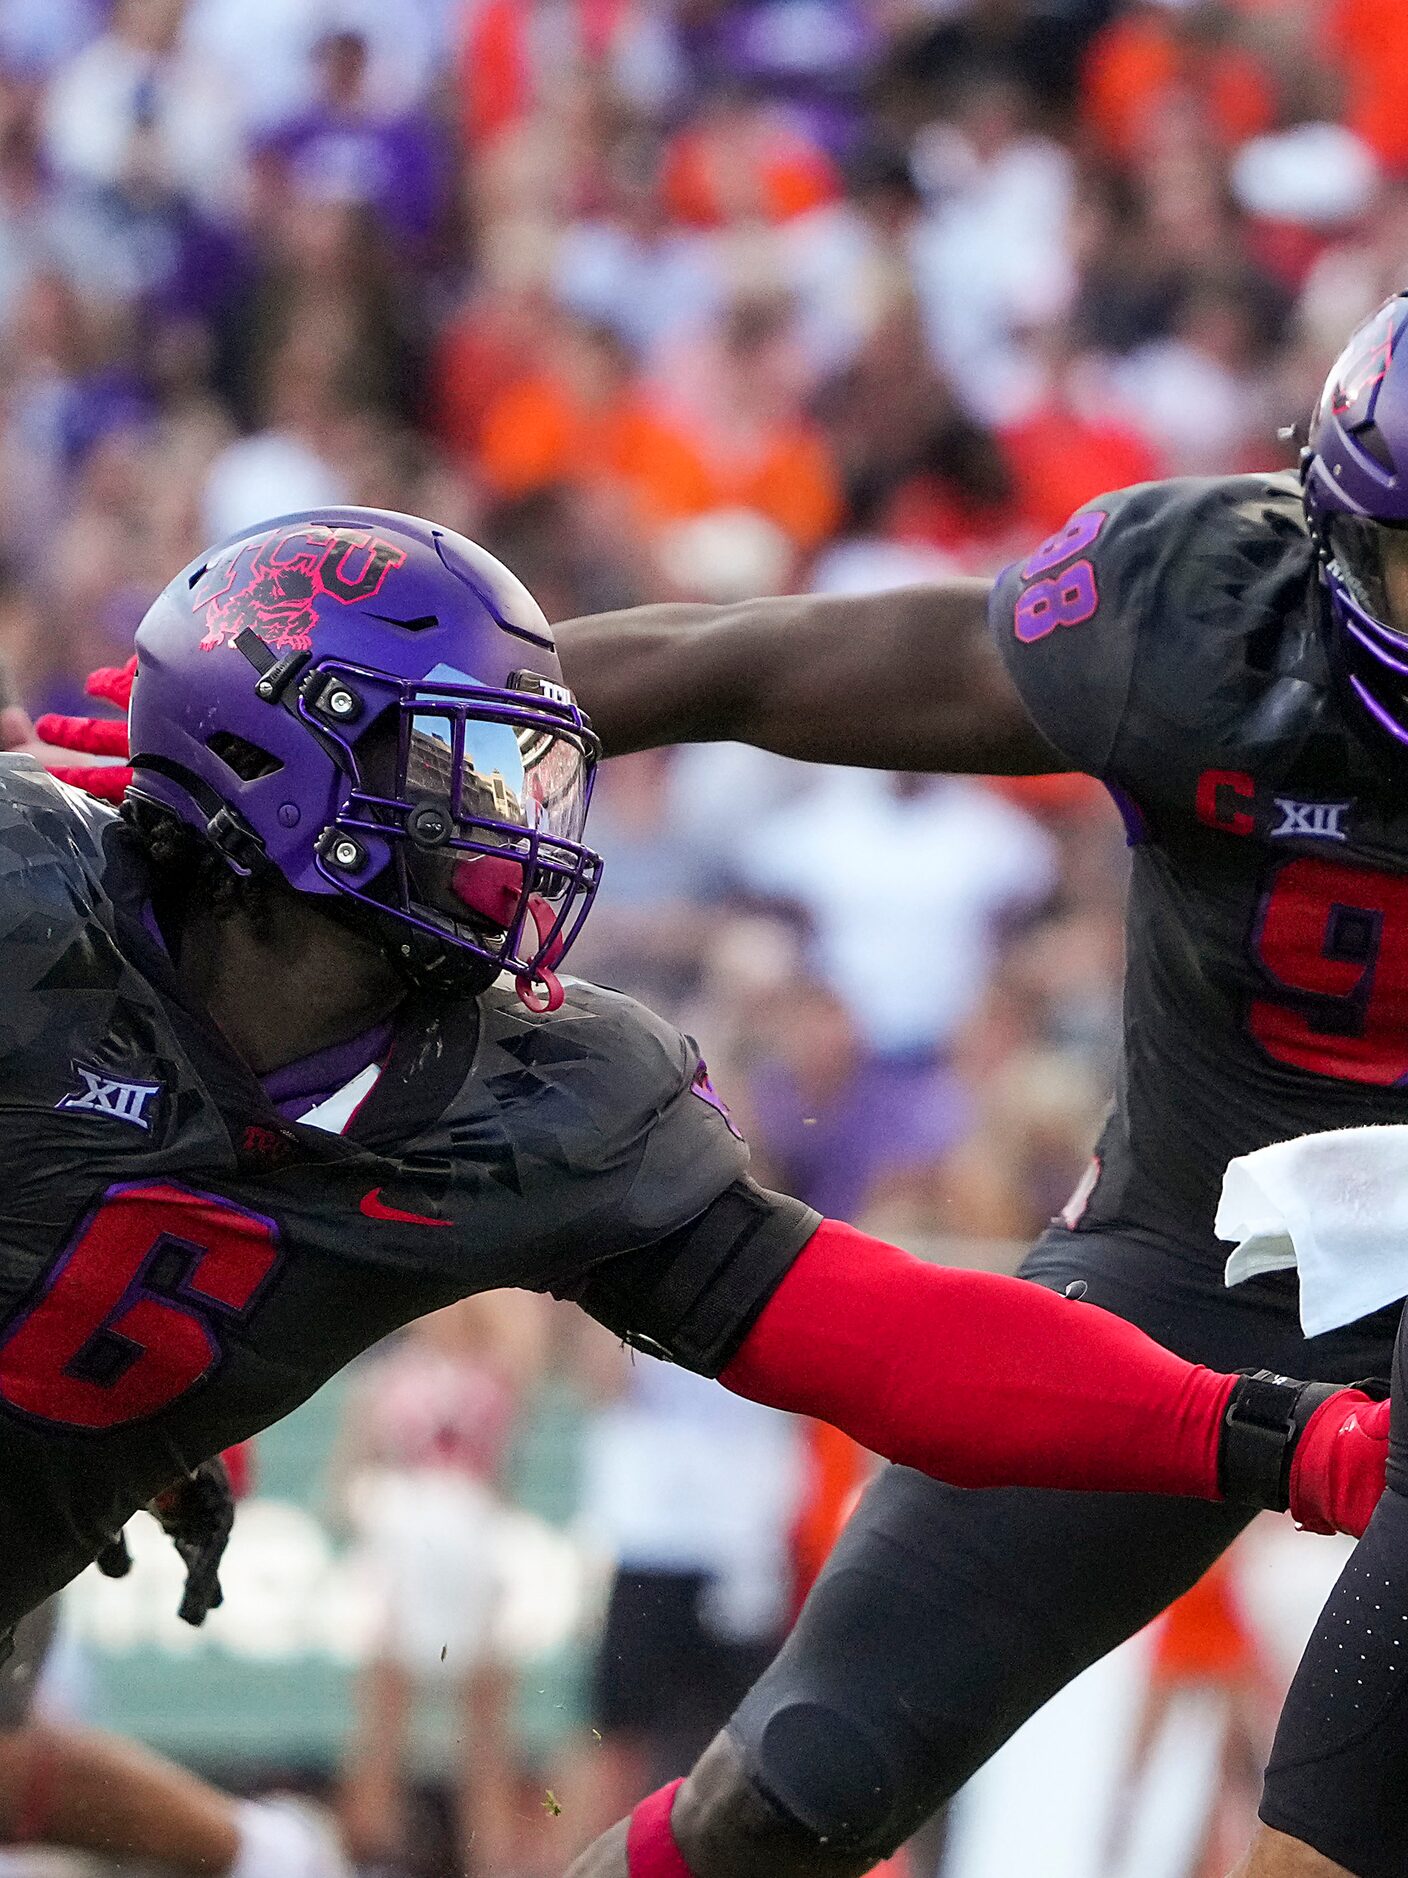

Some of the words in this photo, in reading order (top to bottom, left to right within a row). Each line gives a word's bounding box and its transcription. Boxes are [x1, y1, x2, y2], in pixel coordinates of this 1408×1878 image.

[192, 525, 408, 614] TCU
[1196, 768, 1255, 836] C
[1271, 797, 1351, 841] XII
[64, 1066, 160, 1129] XII
[0, 1177, 281, 1429] 6
